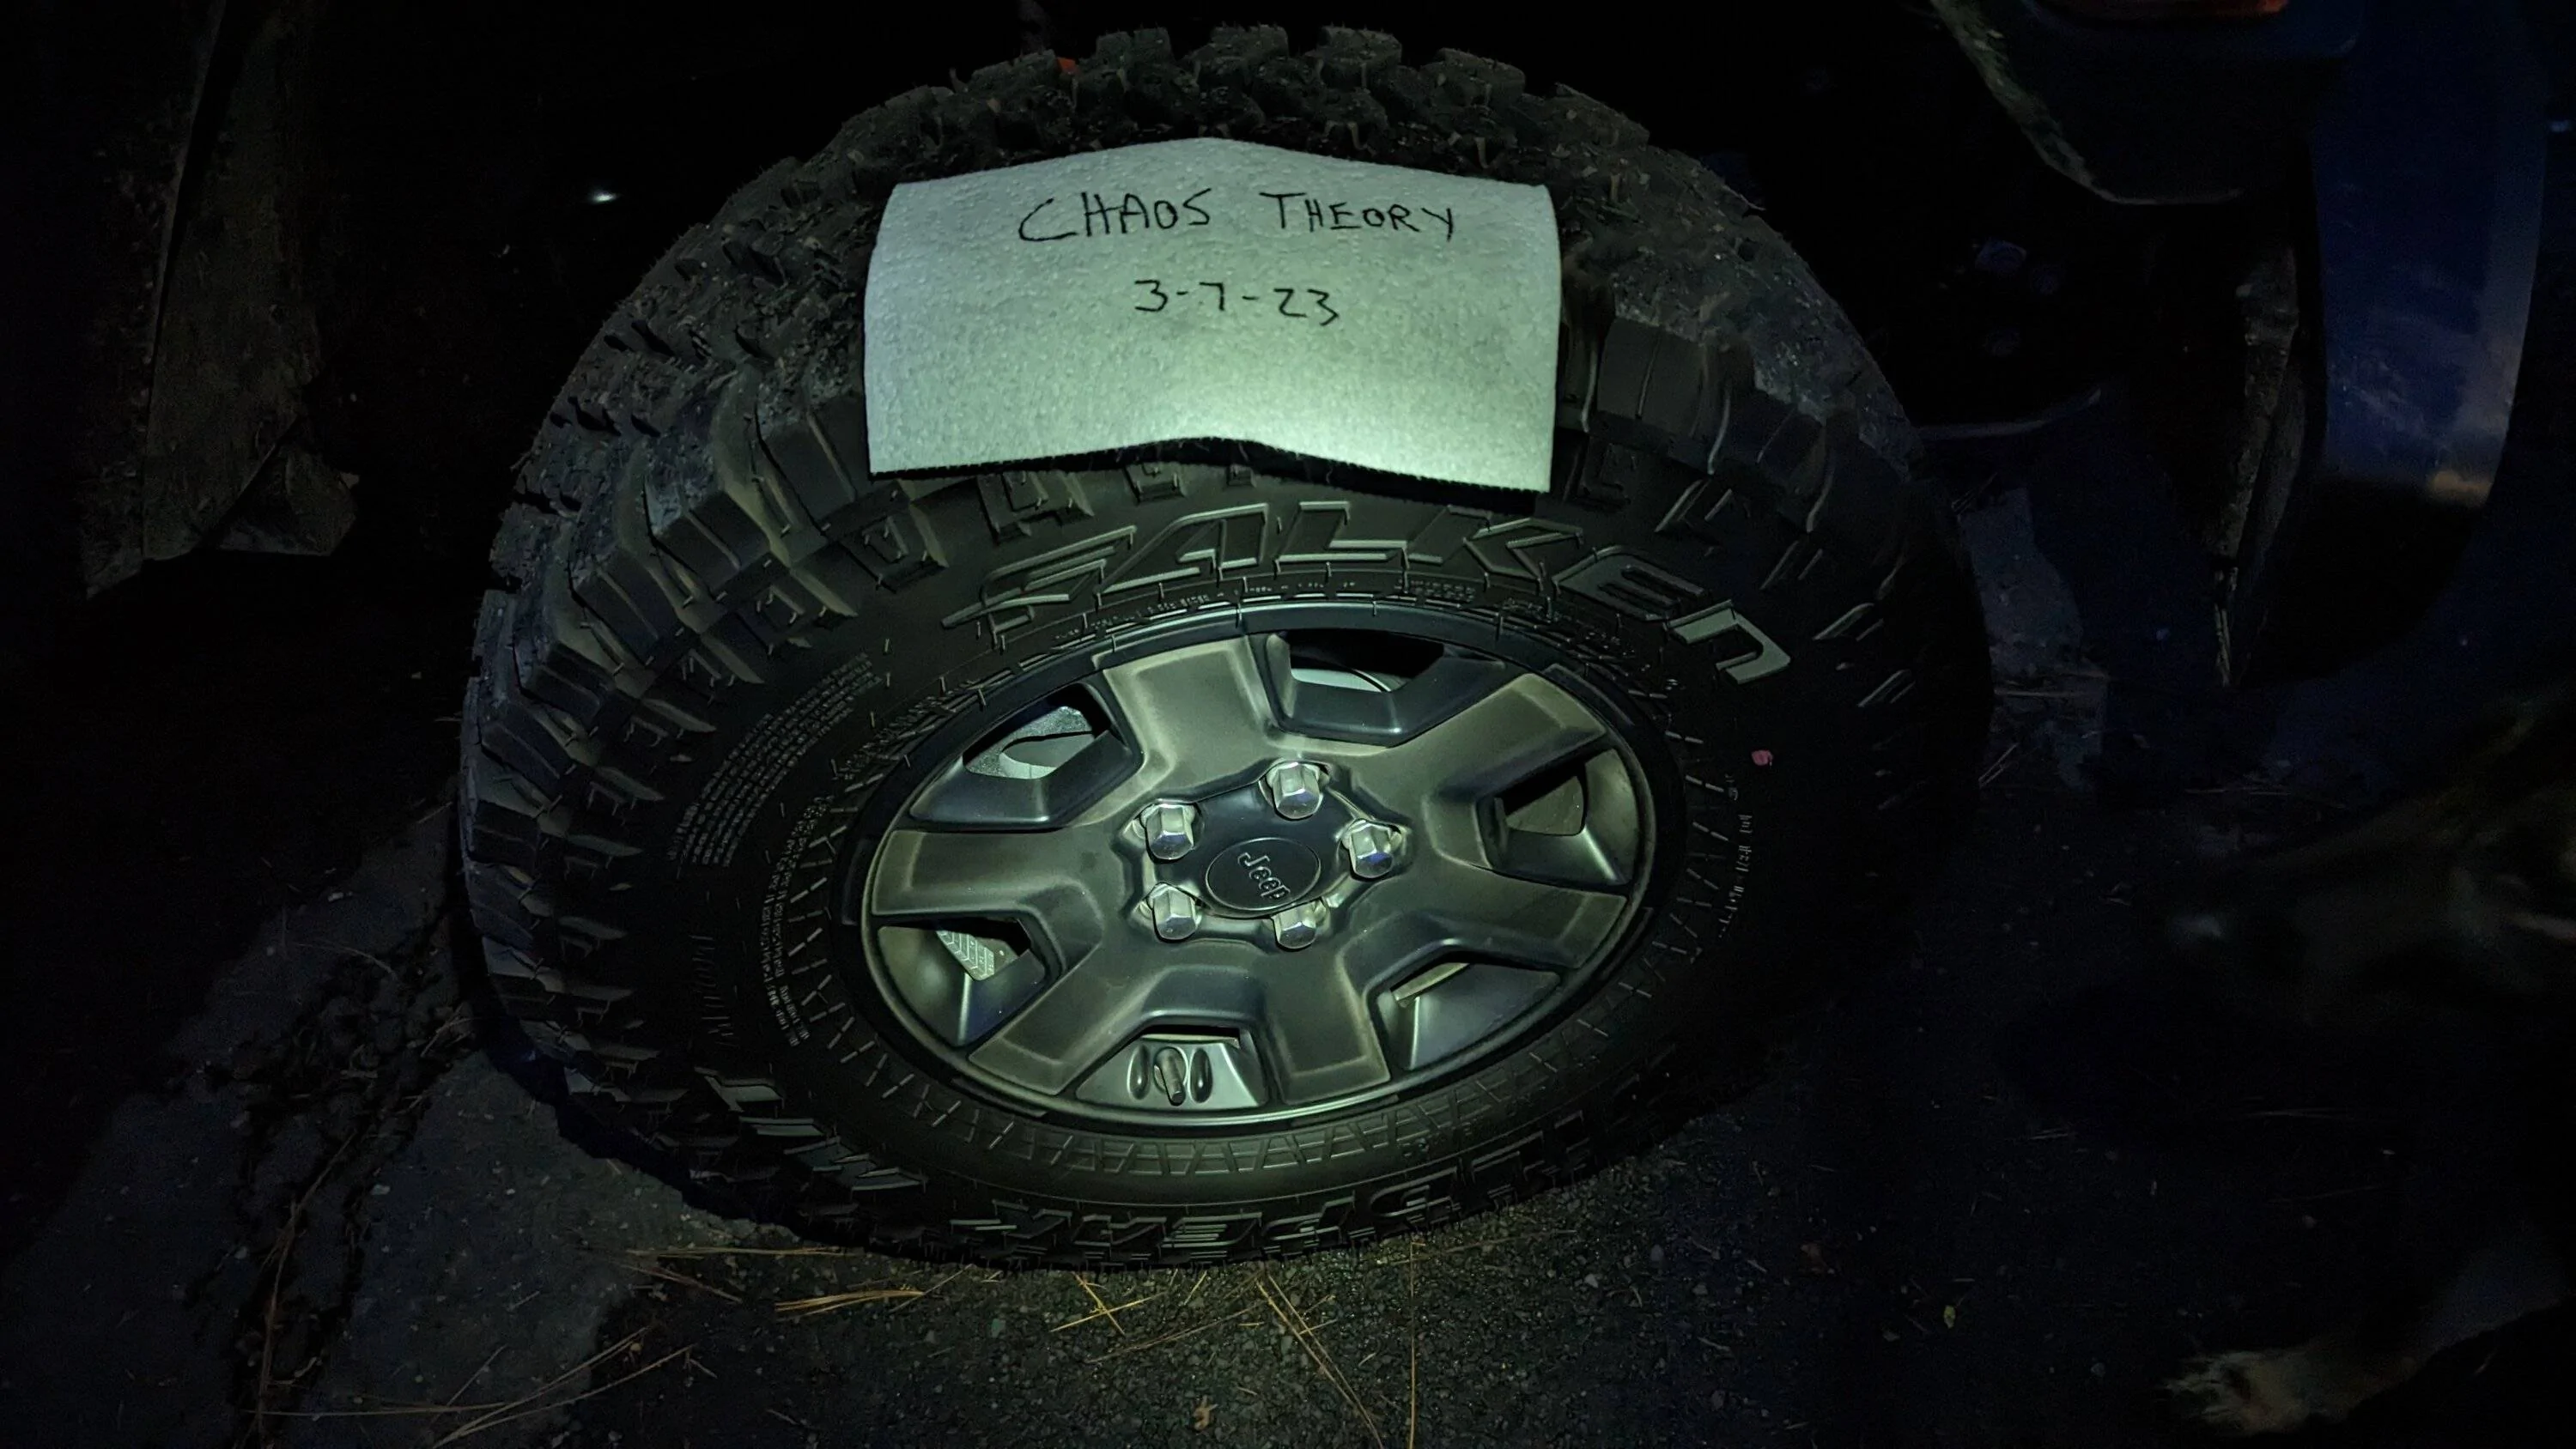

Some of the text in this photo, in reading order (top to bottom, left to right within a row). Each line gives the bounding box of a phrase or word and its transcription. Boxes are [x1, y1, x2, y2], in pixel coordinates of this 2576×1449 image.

[1018, 188, 1455, 242] CHAOS THEORY
[1134, 279, 1339, 326] 3-7-23
[1237, 852, 1291, 900] Jeep
